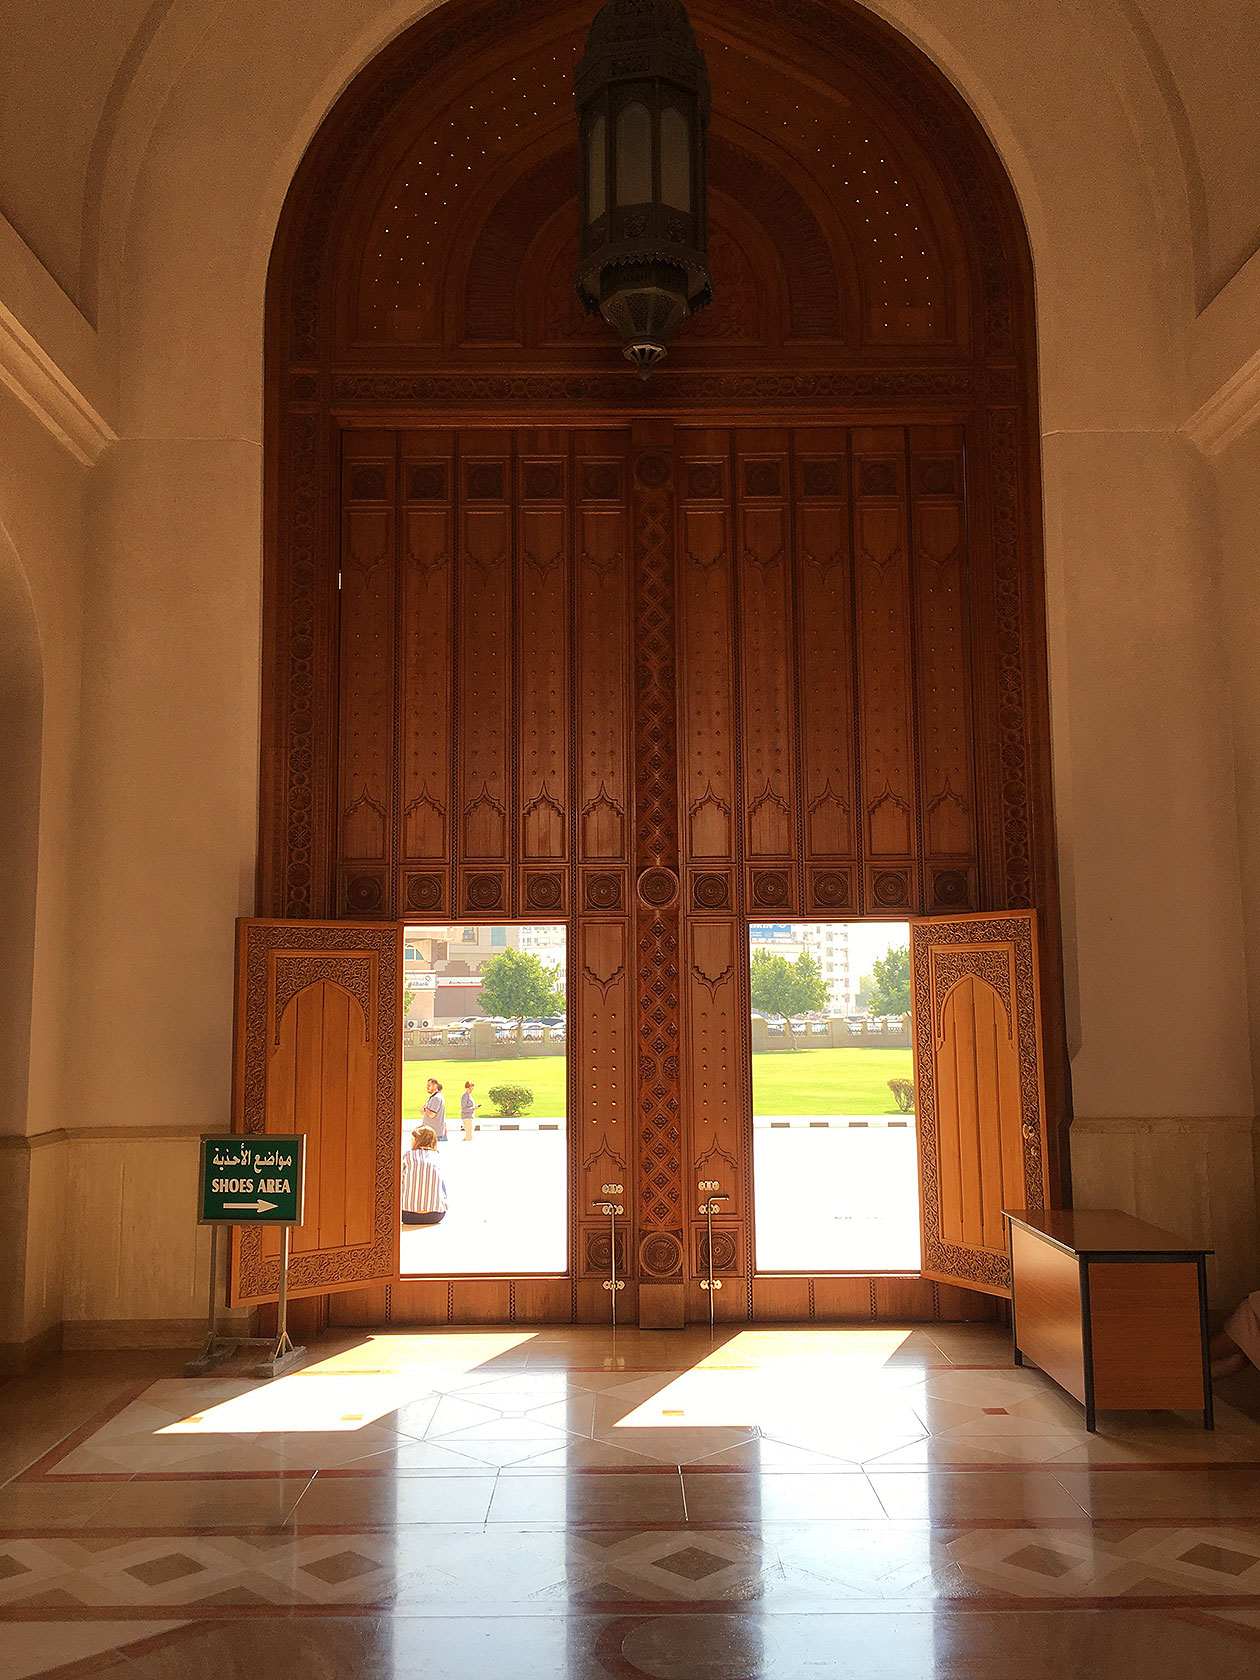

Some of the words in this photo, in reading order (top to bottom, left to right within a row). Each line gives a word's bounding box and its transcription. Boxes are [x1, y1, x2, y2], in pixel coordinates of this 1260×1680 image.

[212, 1142, 251, 1171] الأحذية
[253, 1149, 292, 1174] مواضع
[211, 1178, 254, 1193] SHOES
[257, 1178, 291, 1193] AREA
